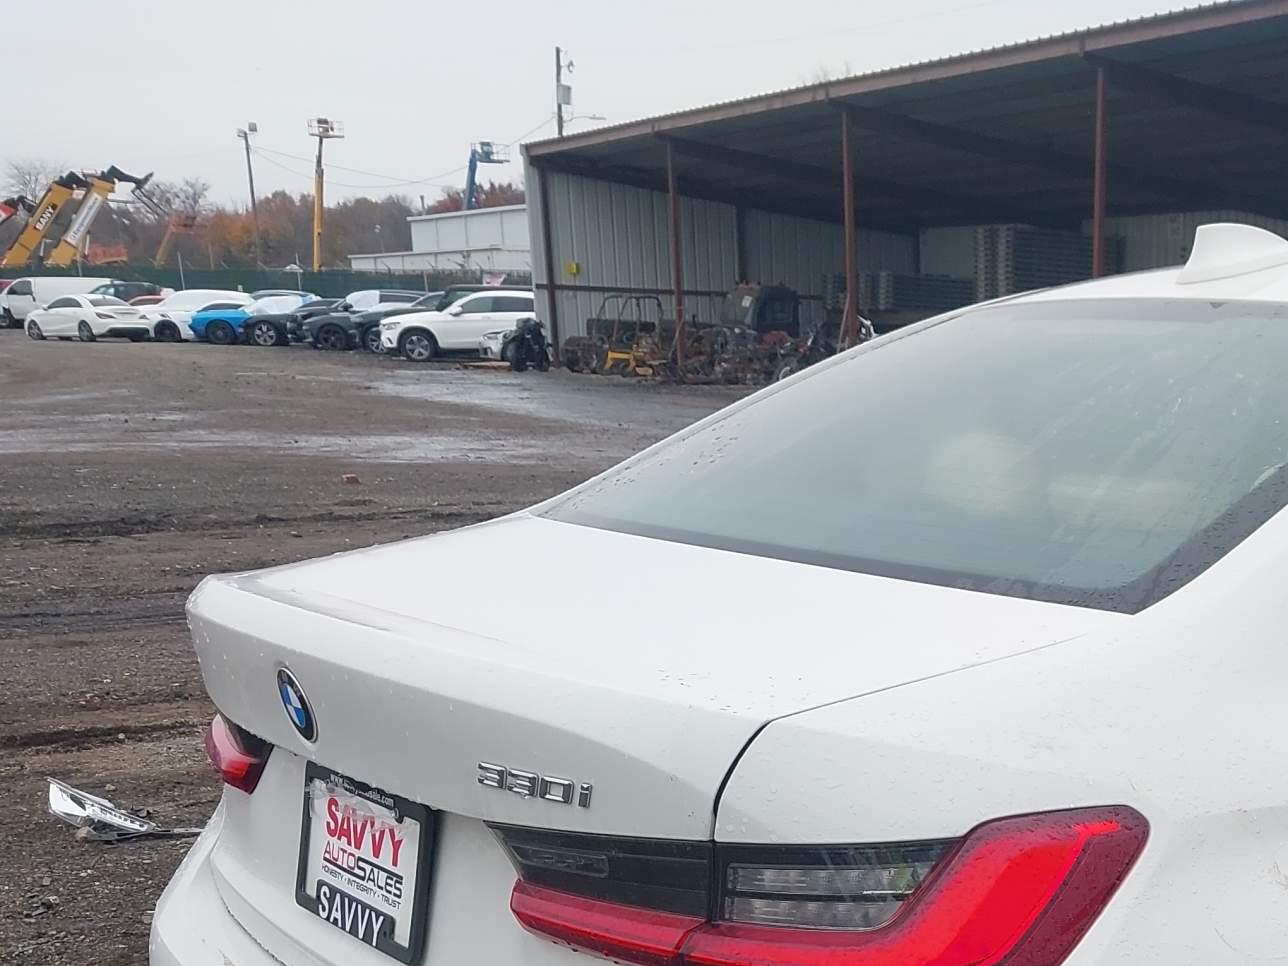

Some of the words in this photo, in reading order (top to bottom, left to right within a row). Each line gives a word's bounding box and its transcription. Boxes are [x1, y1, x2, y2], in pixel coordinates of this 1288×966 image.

[478, 761, 592, 808] 330i
[326, 796, 404, 867] SAVVY
[318, 885, 385, 947] SAVVY
[380, 893, 402, 910] TRUST
